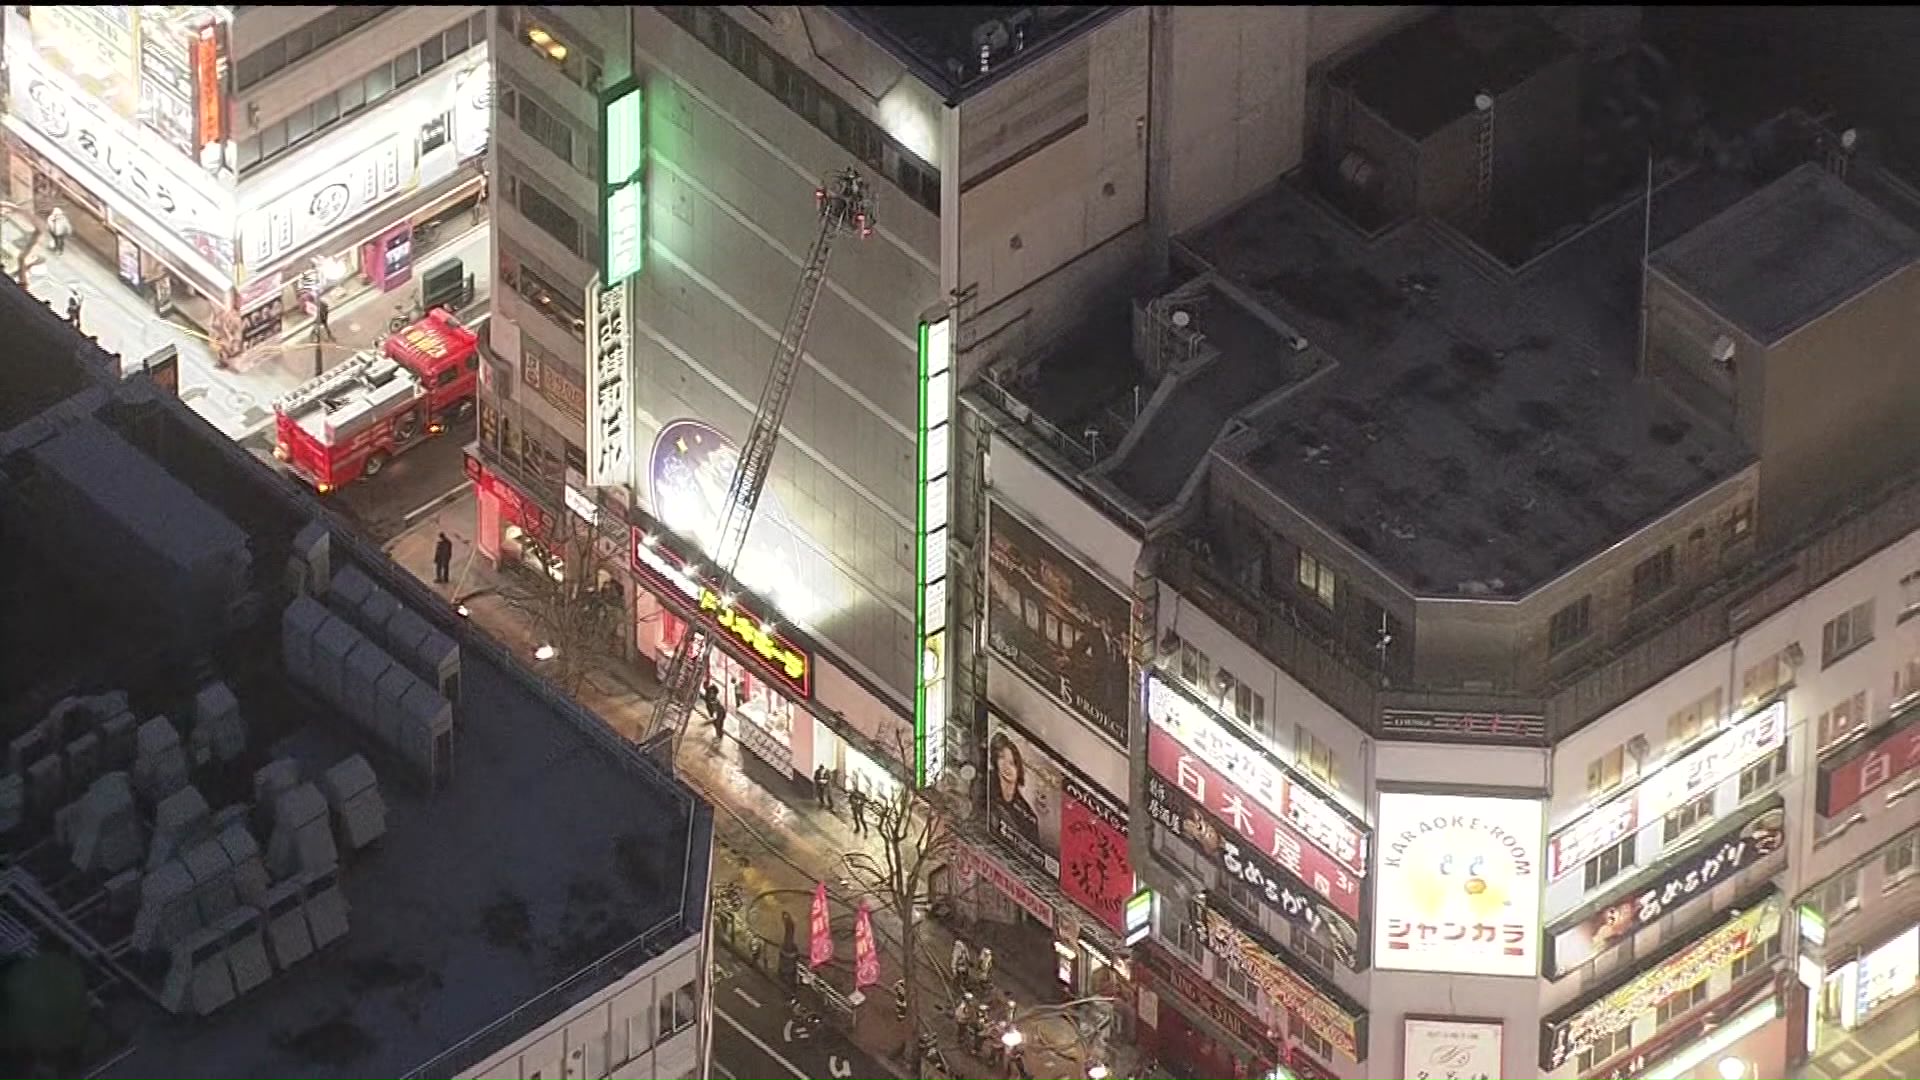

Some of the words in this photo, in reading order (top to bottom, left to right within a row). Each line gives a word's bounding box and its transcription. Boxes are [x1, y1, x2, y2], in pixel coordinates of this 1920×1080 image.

[1177, 752, 1303, 878] 白木屋
[1388, 918, 1524, 945] シャンカラ
